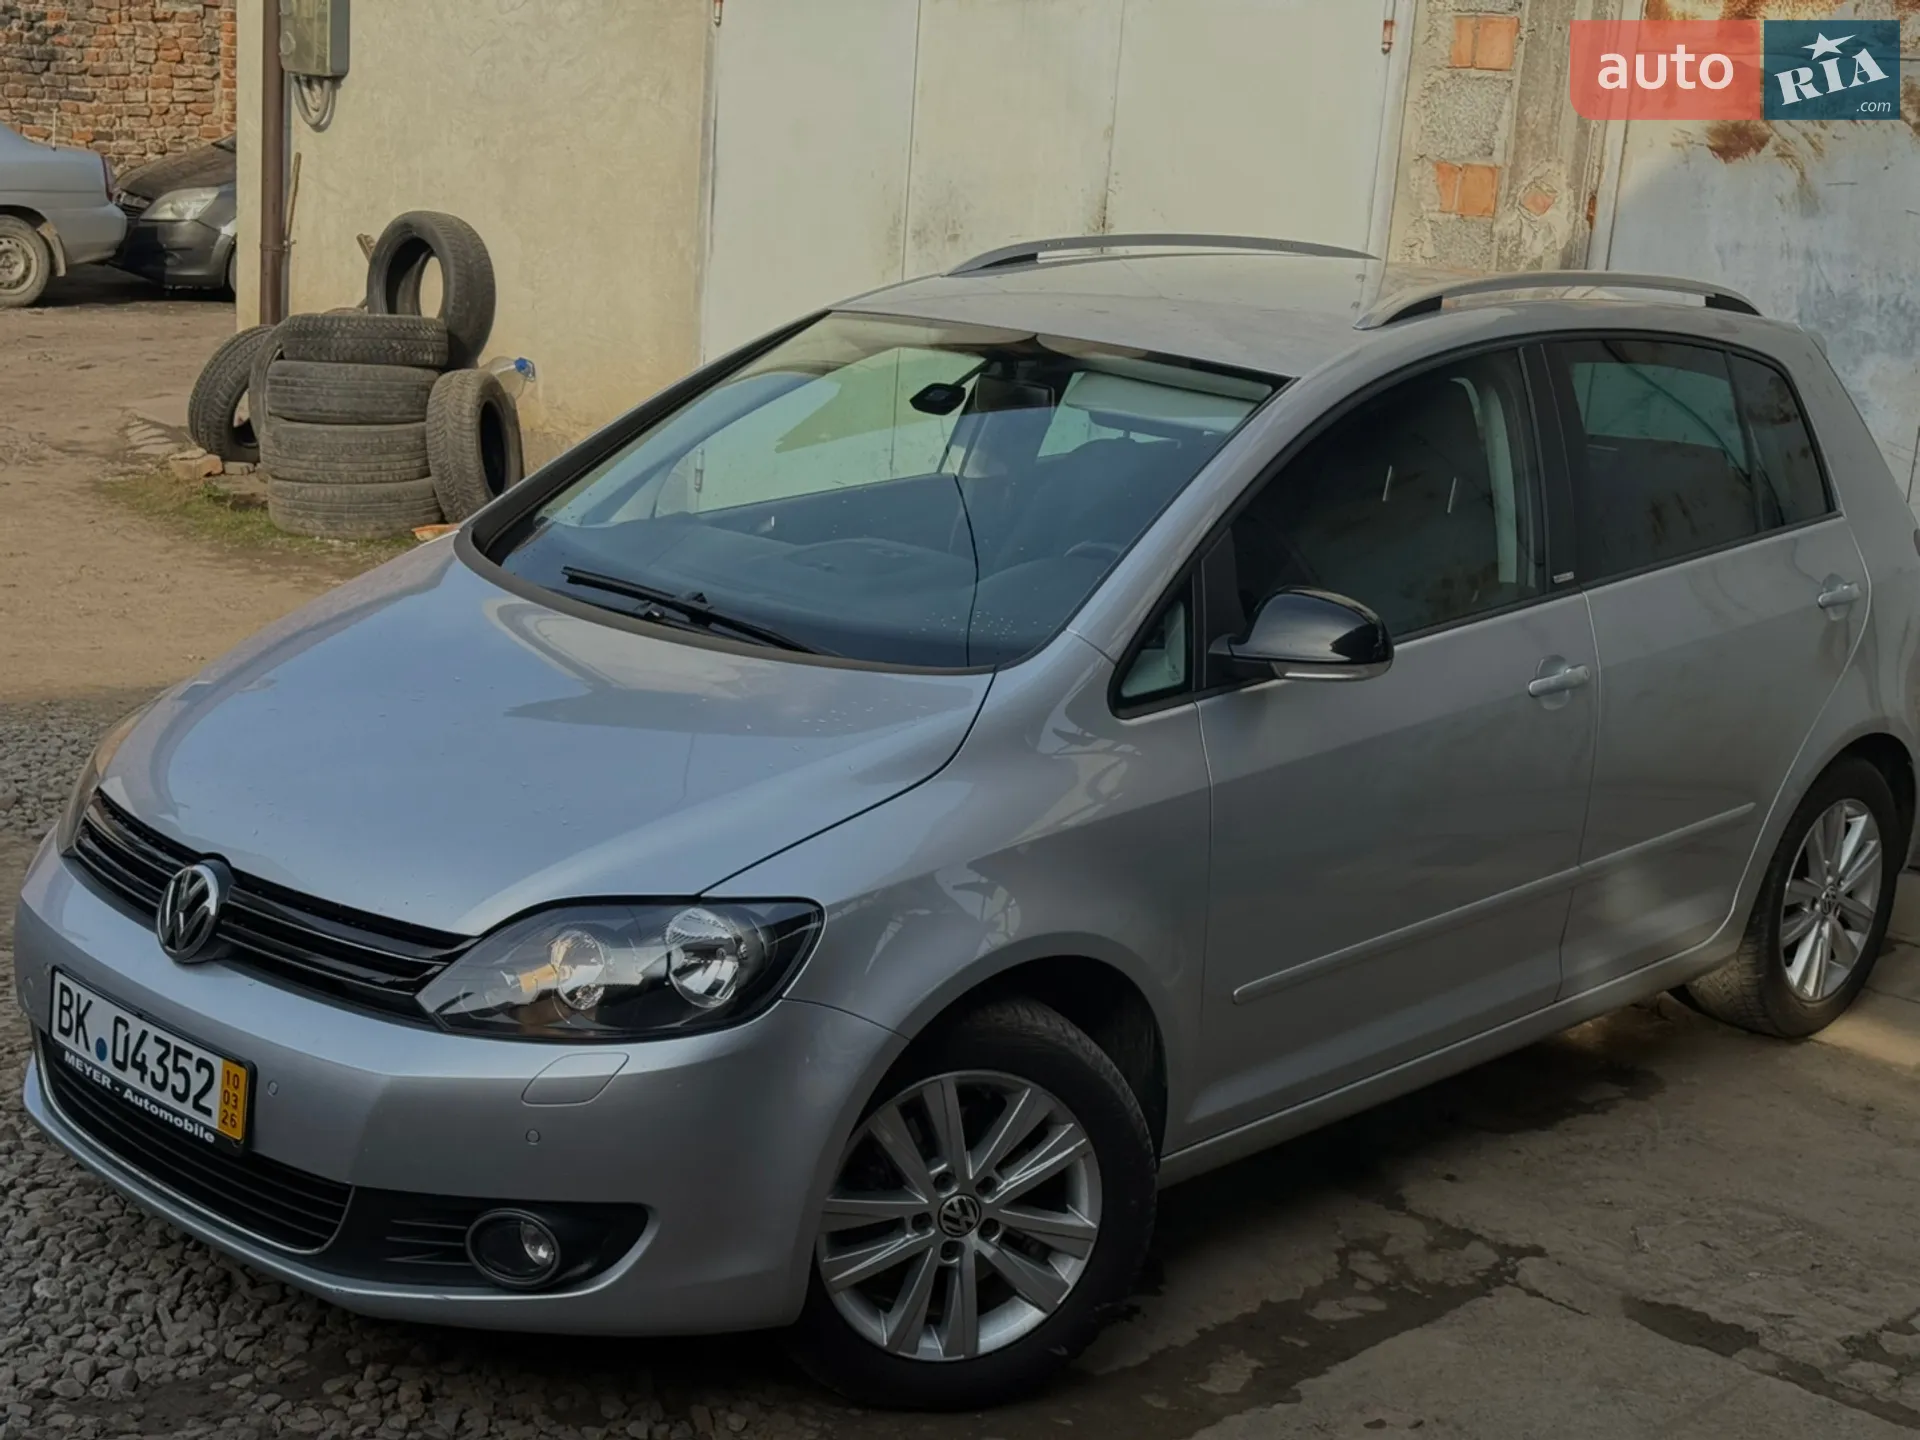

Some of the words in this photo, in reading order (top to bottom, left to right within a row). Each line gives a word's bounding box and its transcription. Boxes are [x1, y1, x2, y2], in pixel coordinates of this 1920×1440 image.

[57, 981, 93, 1052] BK
[111, 1015, 216, 1118] 04352
[225, 1069, 241, 1090] 10
[64, 1051, 112, 1093] MEYER
[123, 1088, 216, 1144] Automobile
[223, 1090, 239, 1110] 03
[221, 1109, 238, 1129] 26
